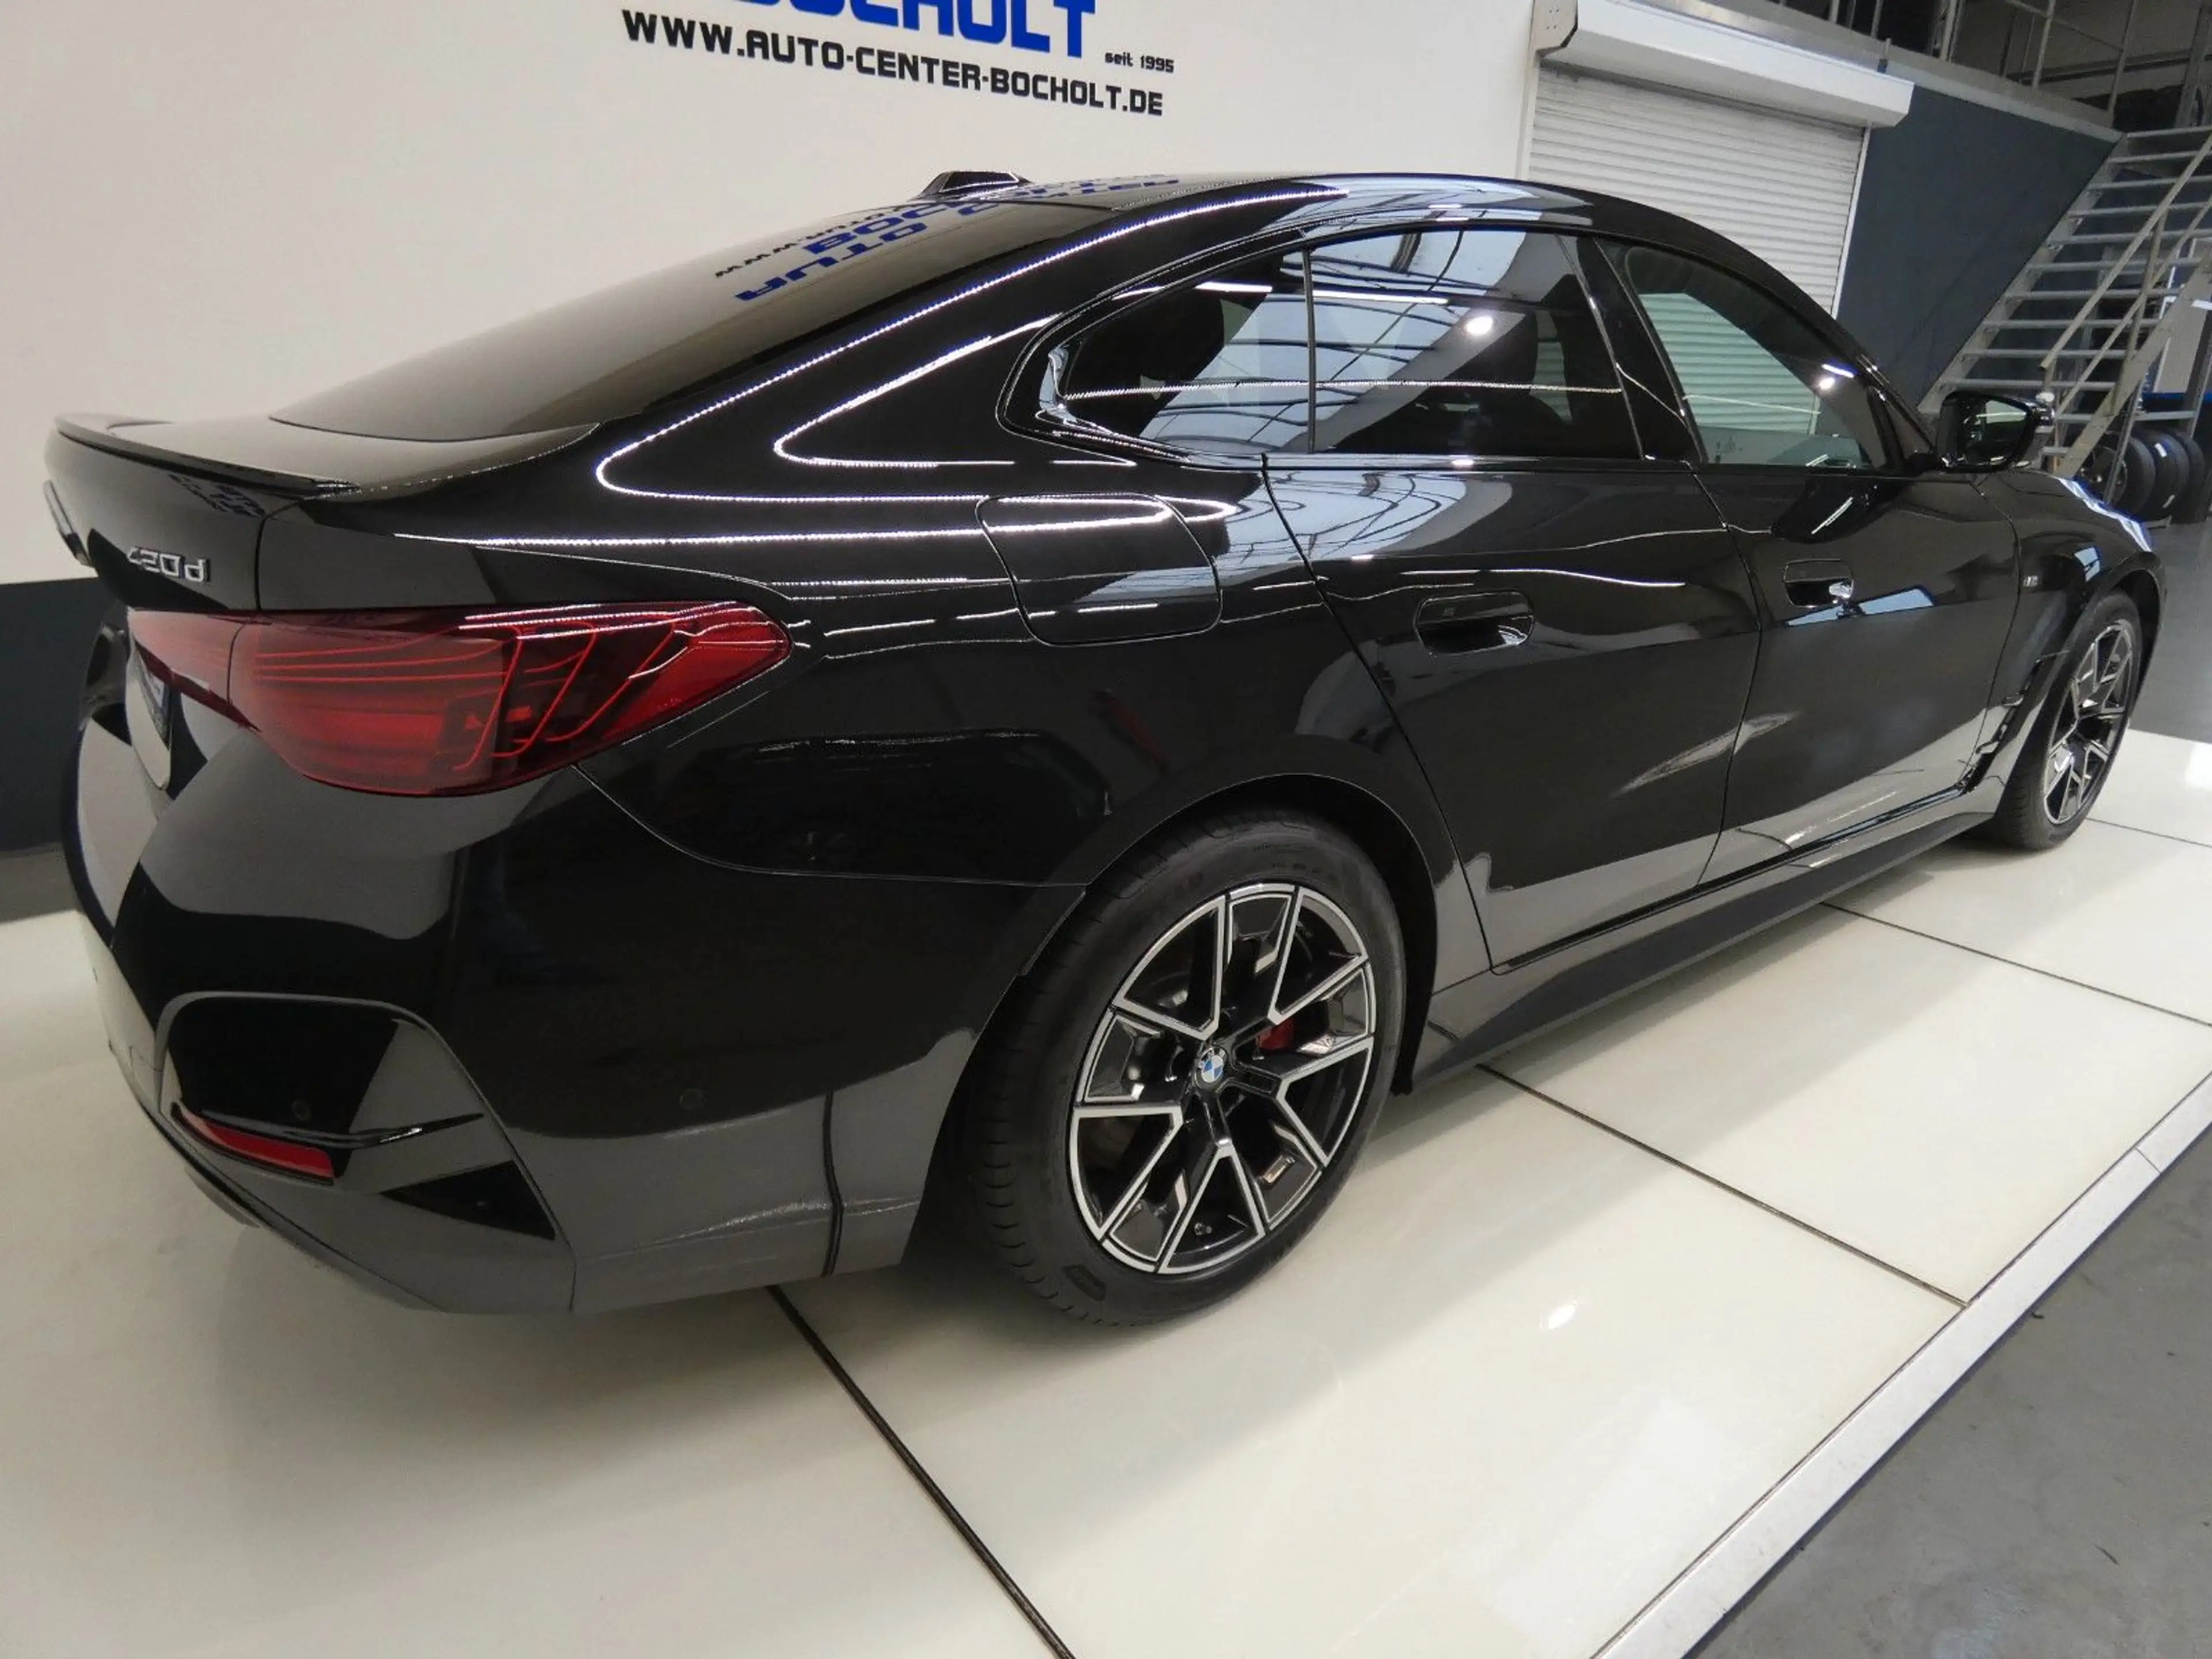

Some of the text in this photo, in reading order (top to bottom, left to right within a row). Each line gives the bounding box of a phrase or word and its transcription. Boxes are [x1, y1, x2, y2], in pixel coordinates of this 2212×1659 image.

[622, 9, 1163, 116] WWW.AUTO-CENTER-BOCHOLT.DE
[1104, 51, 1175, 73] seit 1995
